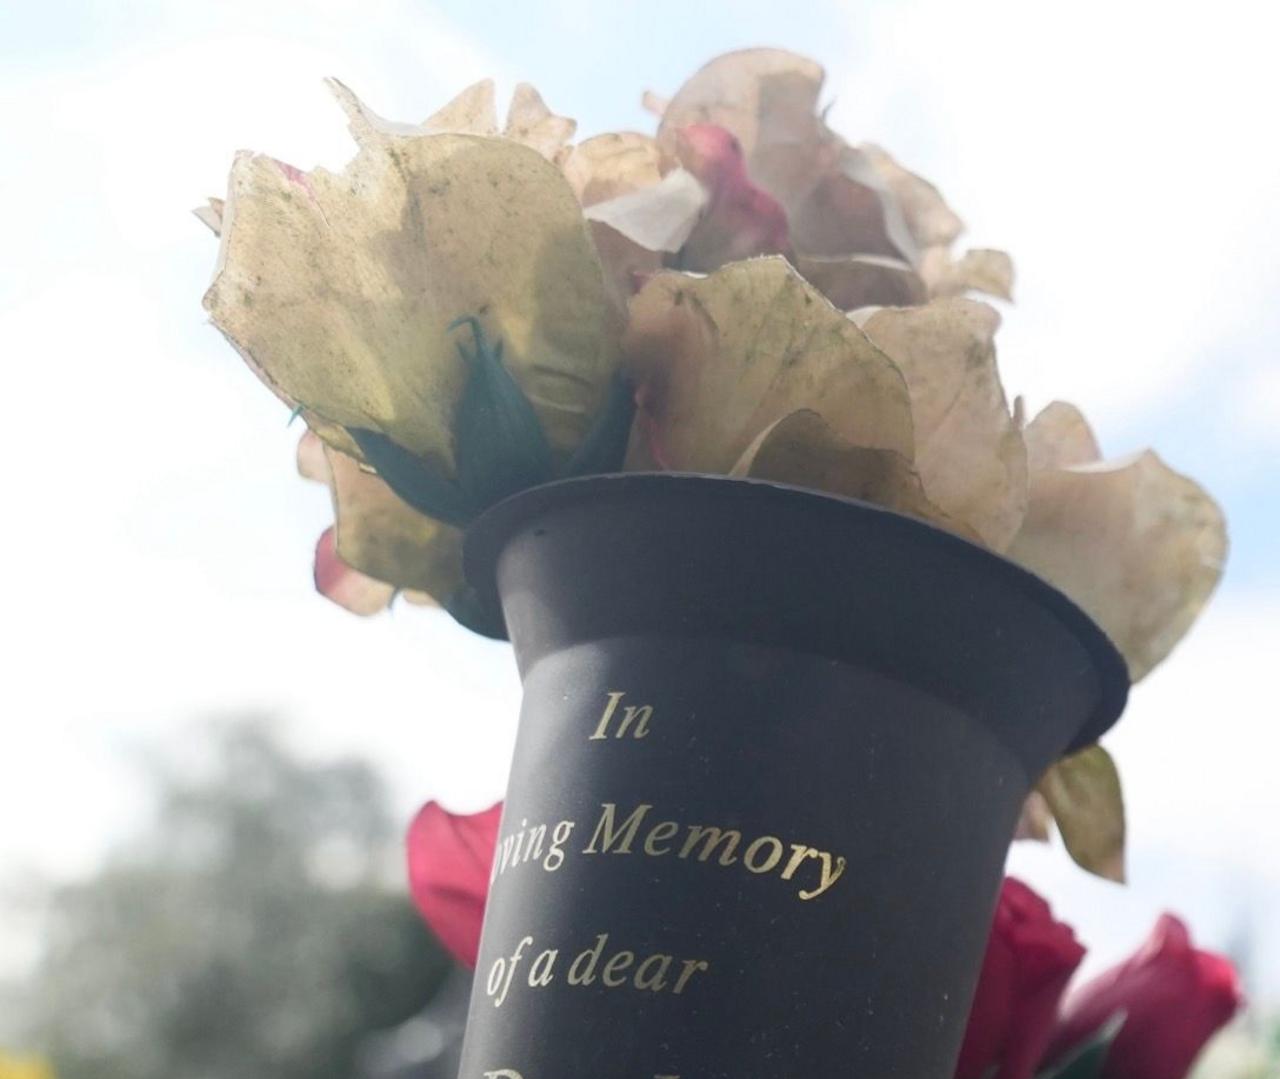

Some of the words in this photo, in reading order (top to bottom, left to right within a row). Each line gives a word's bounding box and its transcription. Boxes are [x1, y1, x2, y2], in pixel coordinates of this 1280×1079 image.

[589, 691, 654, 741] In
[583, 803, 846, 899] Memory
[486, 935, 533, 1008] of
[529, 947, 556, 987] a
[568, 935, 708, 994] dear
